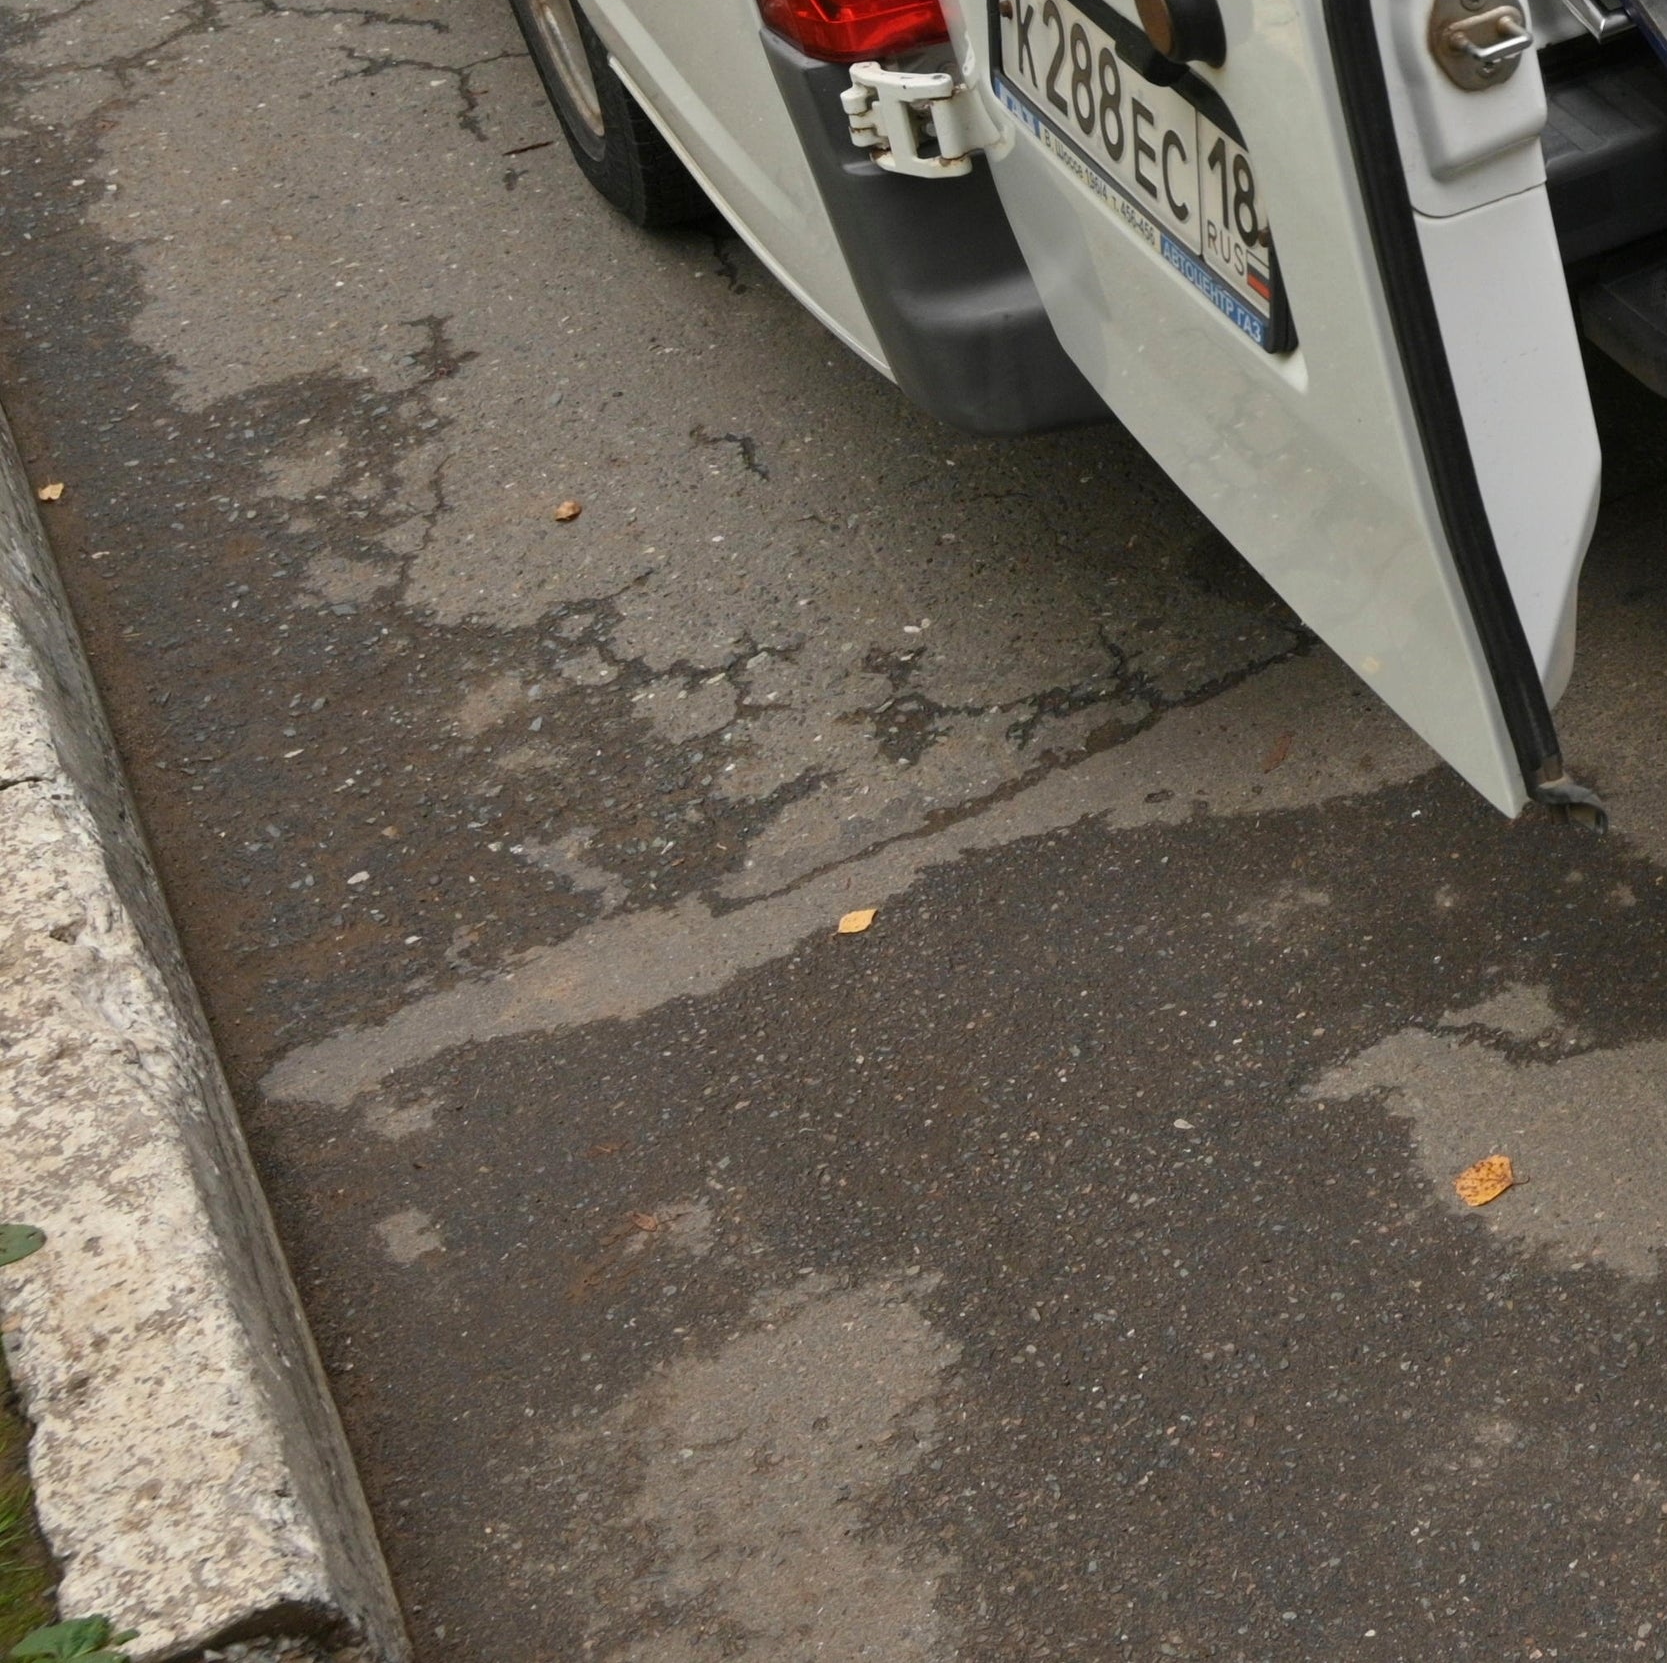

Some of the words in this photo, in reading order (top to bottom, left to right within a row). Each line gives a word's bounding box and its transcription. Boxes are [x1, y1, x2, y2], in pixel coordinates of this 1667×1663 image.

[1207, 136, 1259, 247] 18
[1162, 240, 1234, 317] АВТОЦЕНТР
[1236, 307, 1263, 345] ГАЗ
[1207, 219, 1245, 277] RUS
